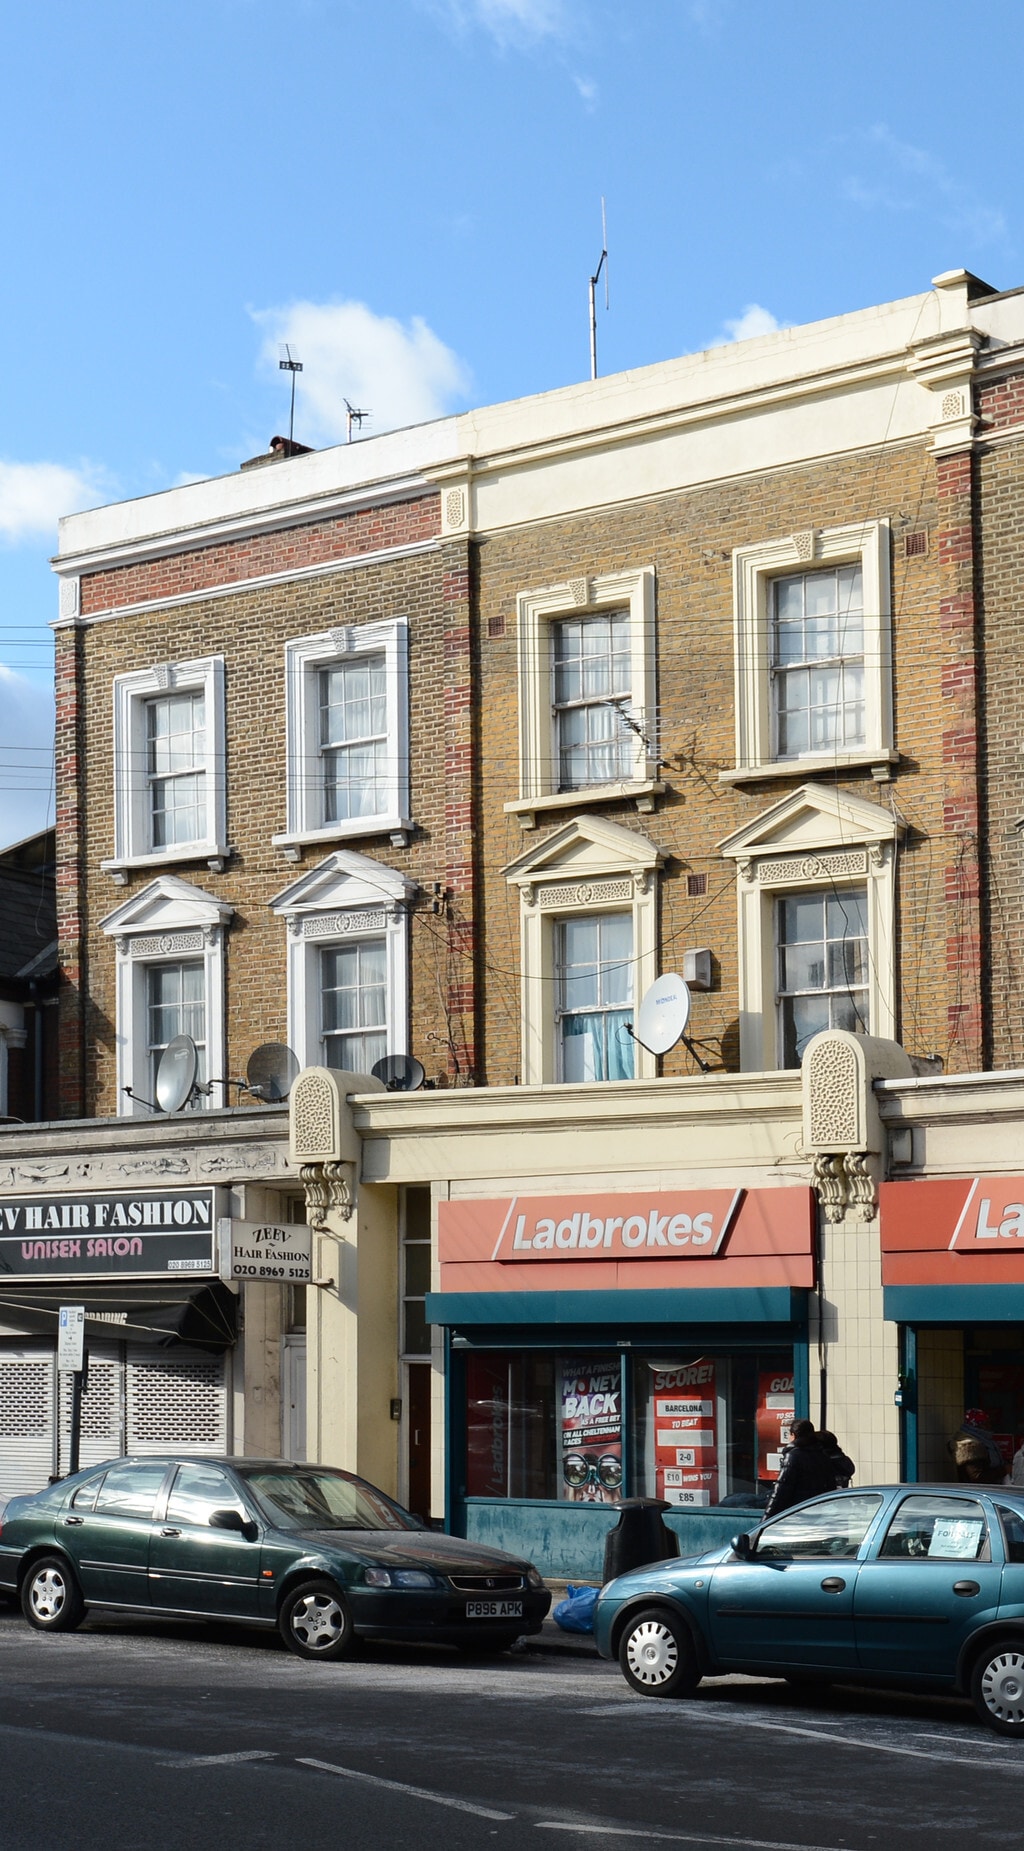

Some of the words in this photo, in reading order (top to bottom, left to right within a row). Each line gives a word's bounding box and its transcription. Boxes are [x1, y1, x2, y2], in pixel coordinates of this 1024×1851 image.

[25, 1204, 90, 1230] HAIR
[94, 1199, 211, 1227] FASHION
[252, 1227, 292, 1243] ZEEV
[512, 1209, 714, 1251] Ladbrokes
[22, 1240, 81, 1260] UNISEX
[87, 1237, 143, 1258] SALON
[233, 1264, 257, 1275] 020
[259, 1266, 285, 1276] 8969
[288, 1268, 310, 1278] 5125
[655, 1364, 714, 1390] SCORE!
[563, 1392, 620, 1419] BACK
[665, 1404, 703, 1413] BARCELONA
[671, 1420, 681, 1429] TO
[679, 1453, 691, 1461] 2-0
[667, 1473, 680, 1481] £10
[679, 1492, 695, 1502] £85
[467, 1603, 497, 1615] P896
[500, 1602, 522, 1615] APK
